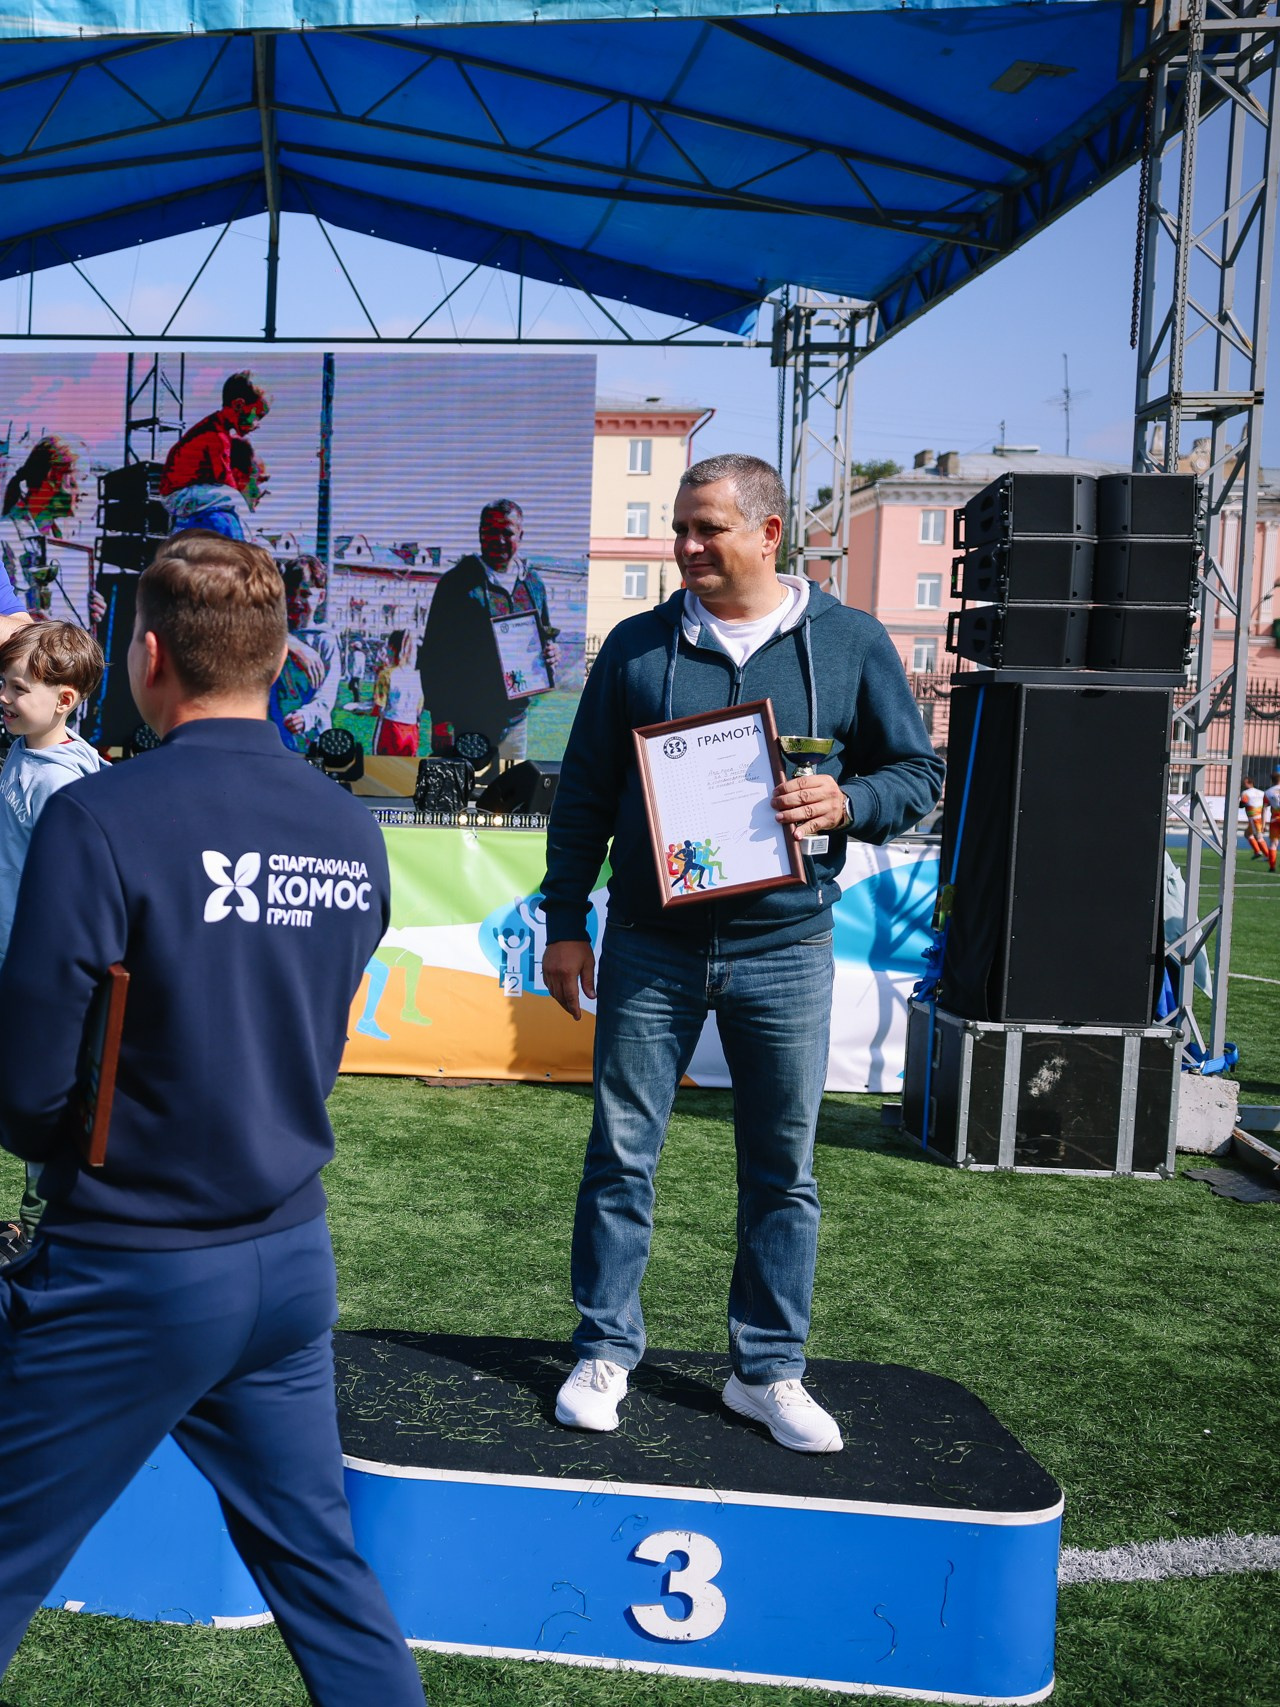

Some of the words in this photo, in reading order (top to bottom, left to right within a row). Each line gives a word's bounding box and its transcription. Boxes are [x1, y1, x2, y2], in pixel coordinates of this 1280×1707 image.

[697, 724, 762, 748] ГРАМОТА
[268, 854, 368, 880] СПАРТАКИАДА
[267, 874, 372, 911] КОМОС
[266, 907, 313, 927] ГРУПП
[508, 976, 520, 994] 2
[629, 1529, 727, 1641] 3
